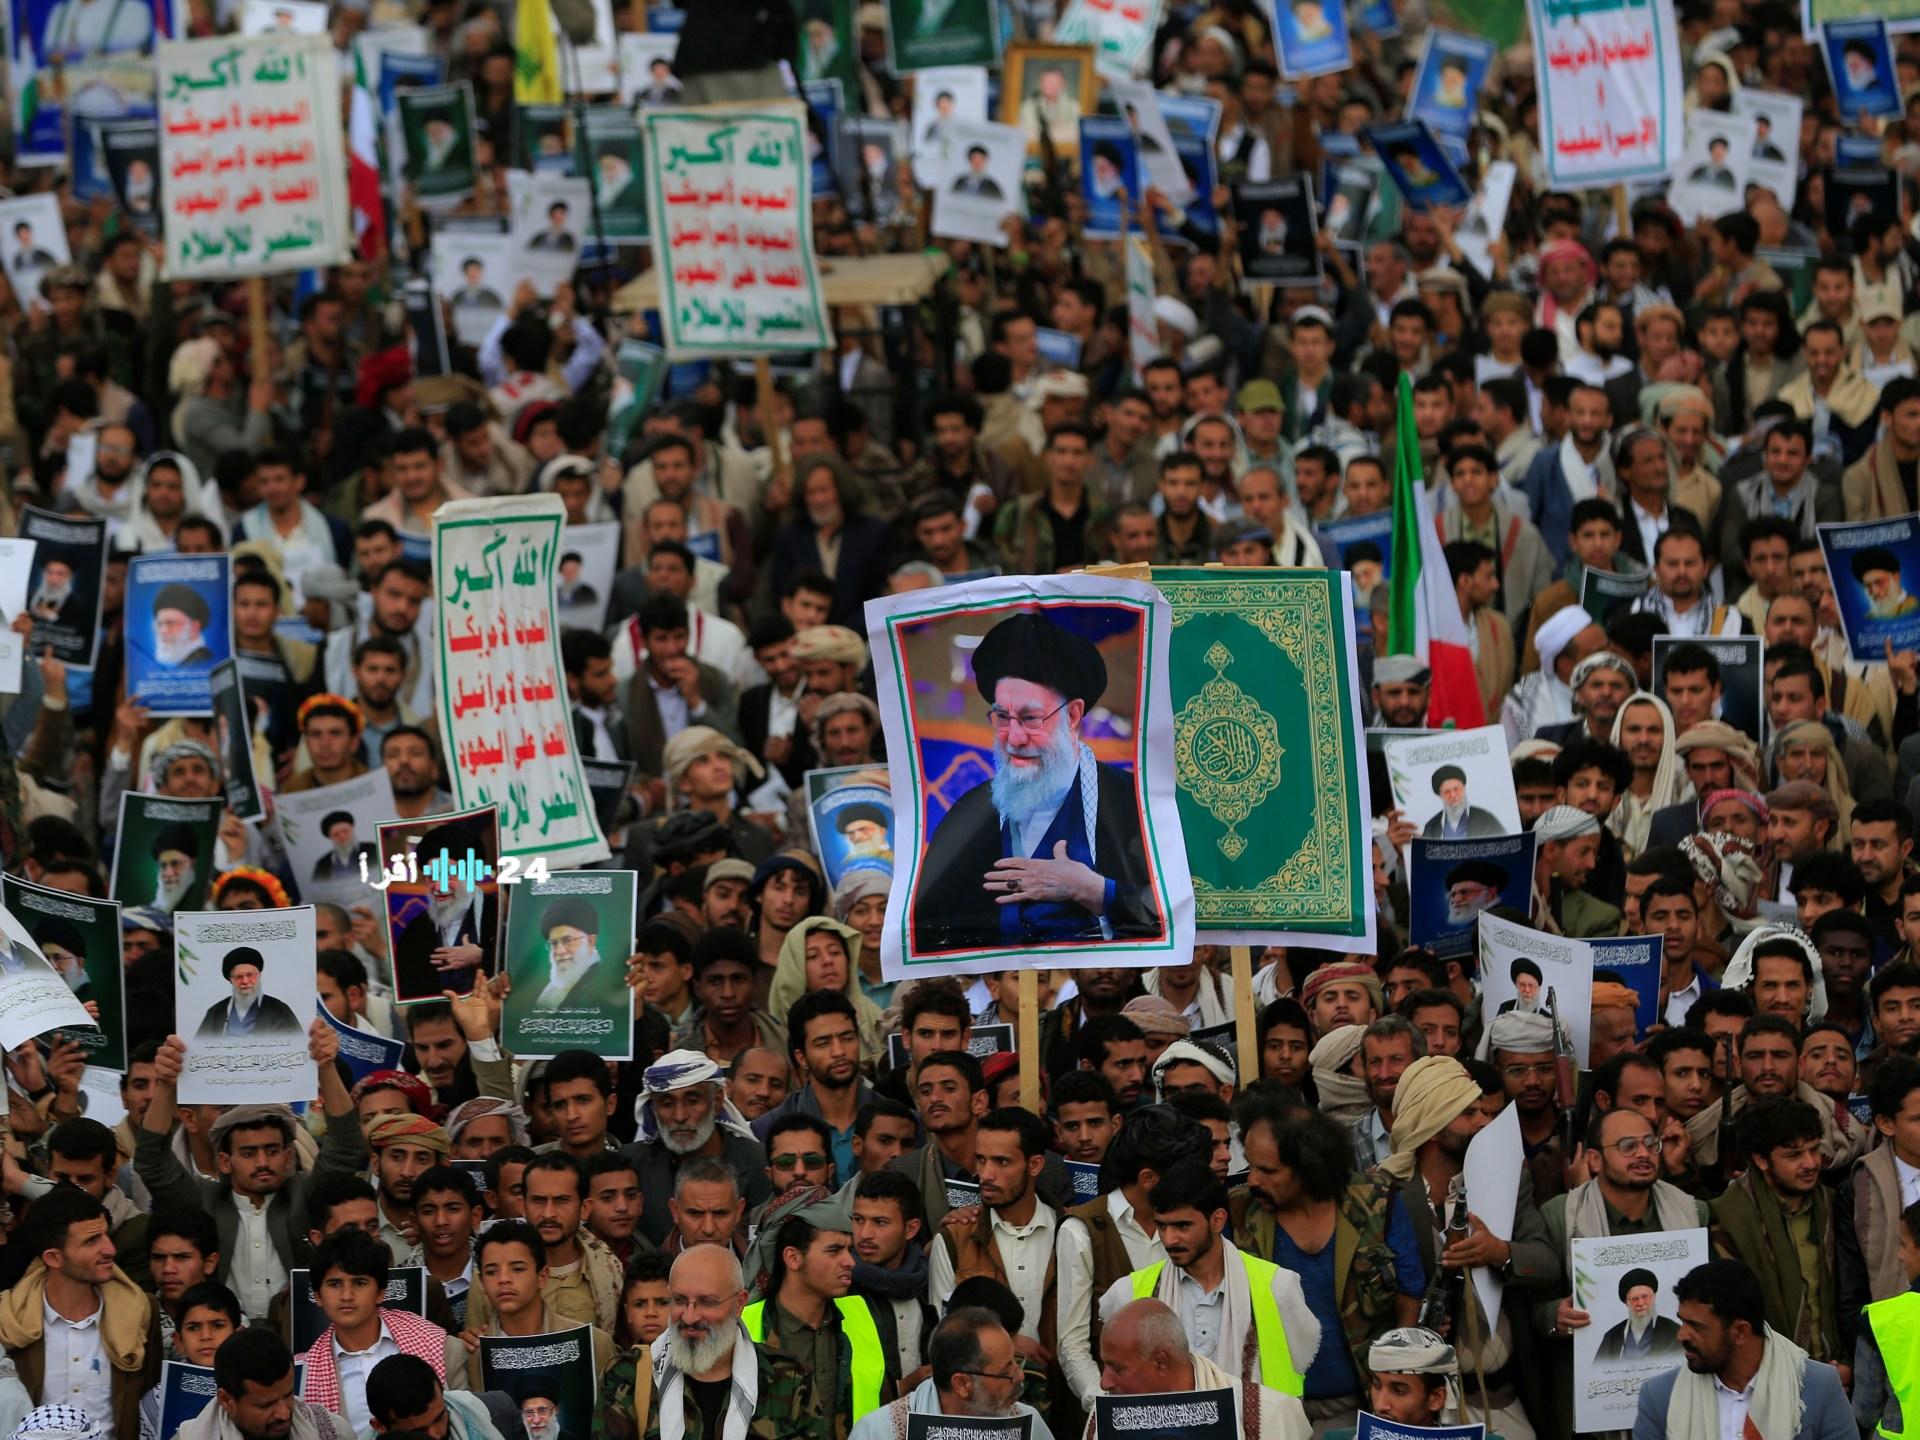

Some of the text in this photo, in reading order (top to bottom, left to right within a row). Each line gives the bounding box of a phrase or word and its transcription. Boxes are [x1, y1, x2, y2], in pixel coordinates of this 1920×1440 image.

[166, 46, 306, 102] الله أكبر
[664, 123, 799, 177] الله أكبر
[445, 528, 550, 610] الله أكبر
